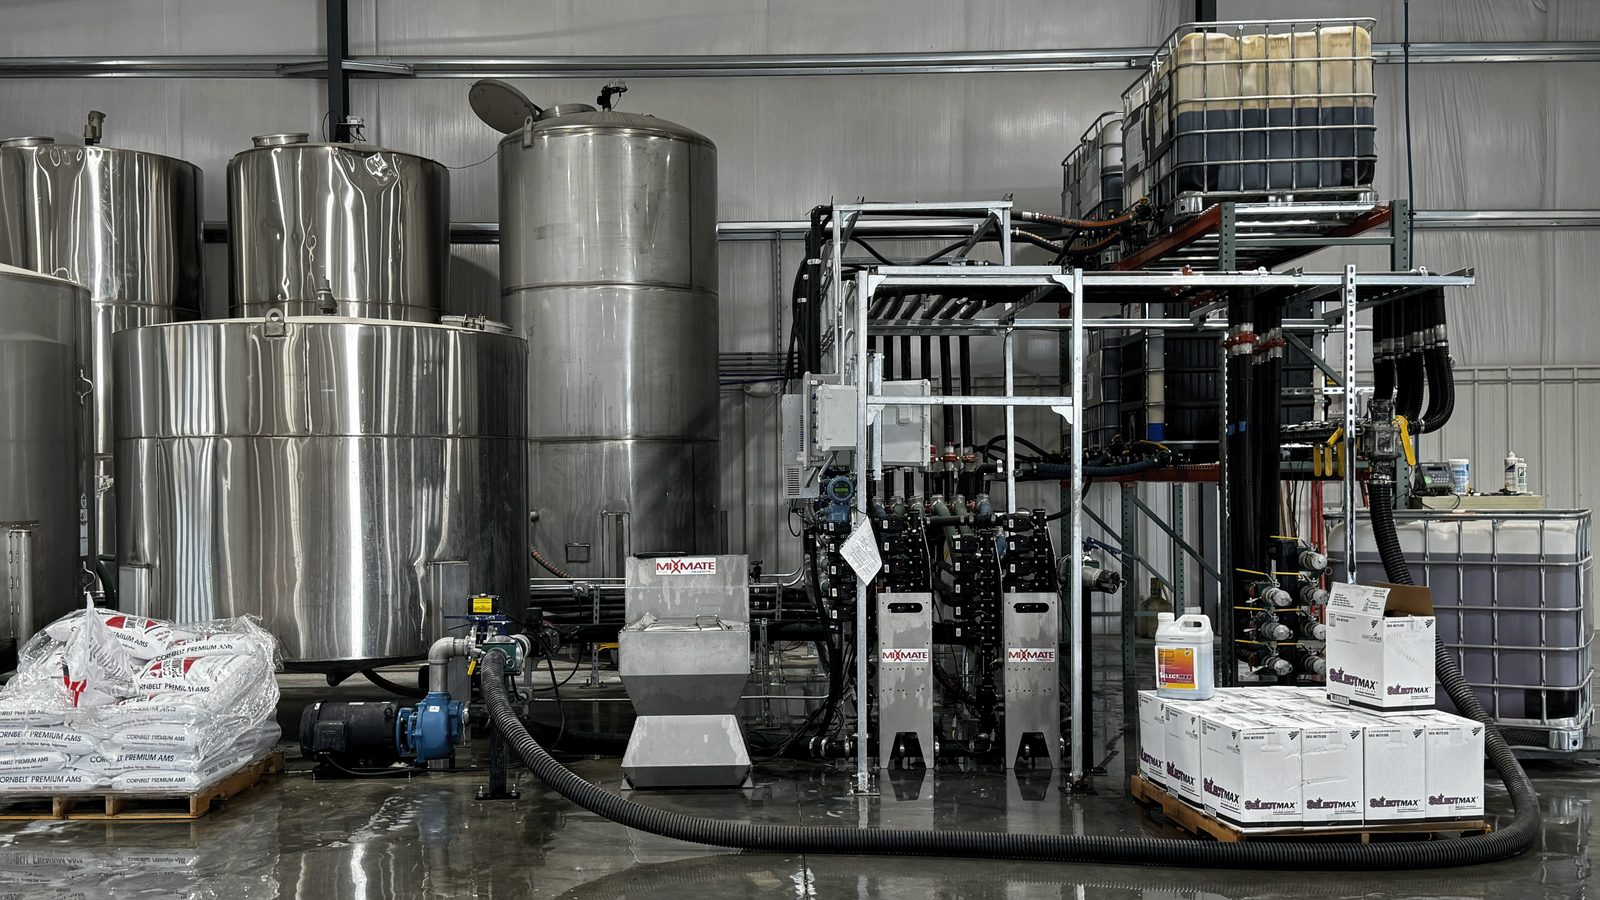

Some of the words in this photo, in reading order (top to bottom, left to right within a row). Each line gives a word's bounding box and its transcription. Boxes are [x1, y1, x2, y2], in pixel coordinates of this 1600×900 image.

[656, 559, 715, 574] MIXMATE
[134, 638, 149, 648] AMS
[156, 648, 185, 661] CORNBELT
[187, 644, 217, 653] PREMIUM
[882, 649, 928, 661] MIXMATE
[1008, 649, 1054, 661] MIXMATE
[29, 731, 64, 741] PREMIUM
[64, 734, 82, 743] AMS
[124, 753, 157, 761] PREMIUM
[157, 754, 175, 762] AMS
[0, 776, 29, 784] ORNBELT
